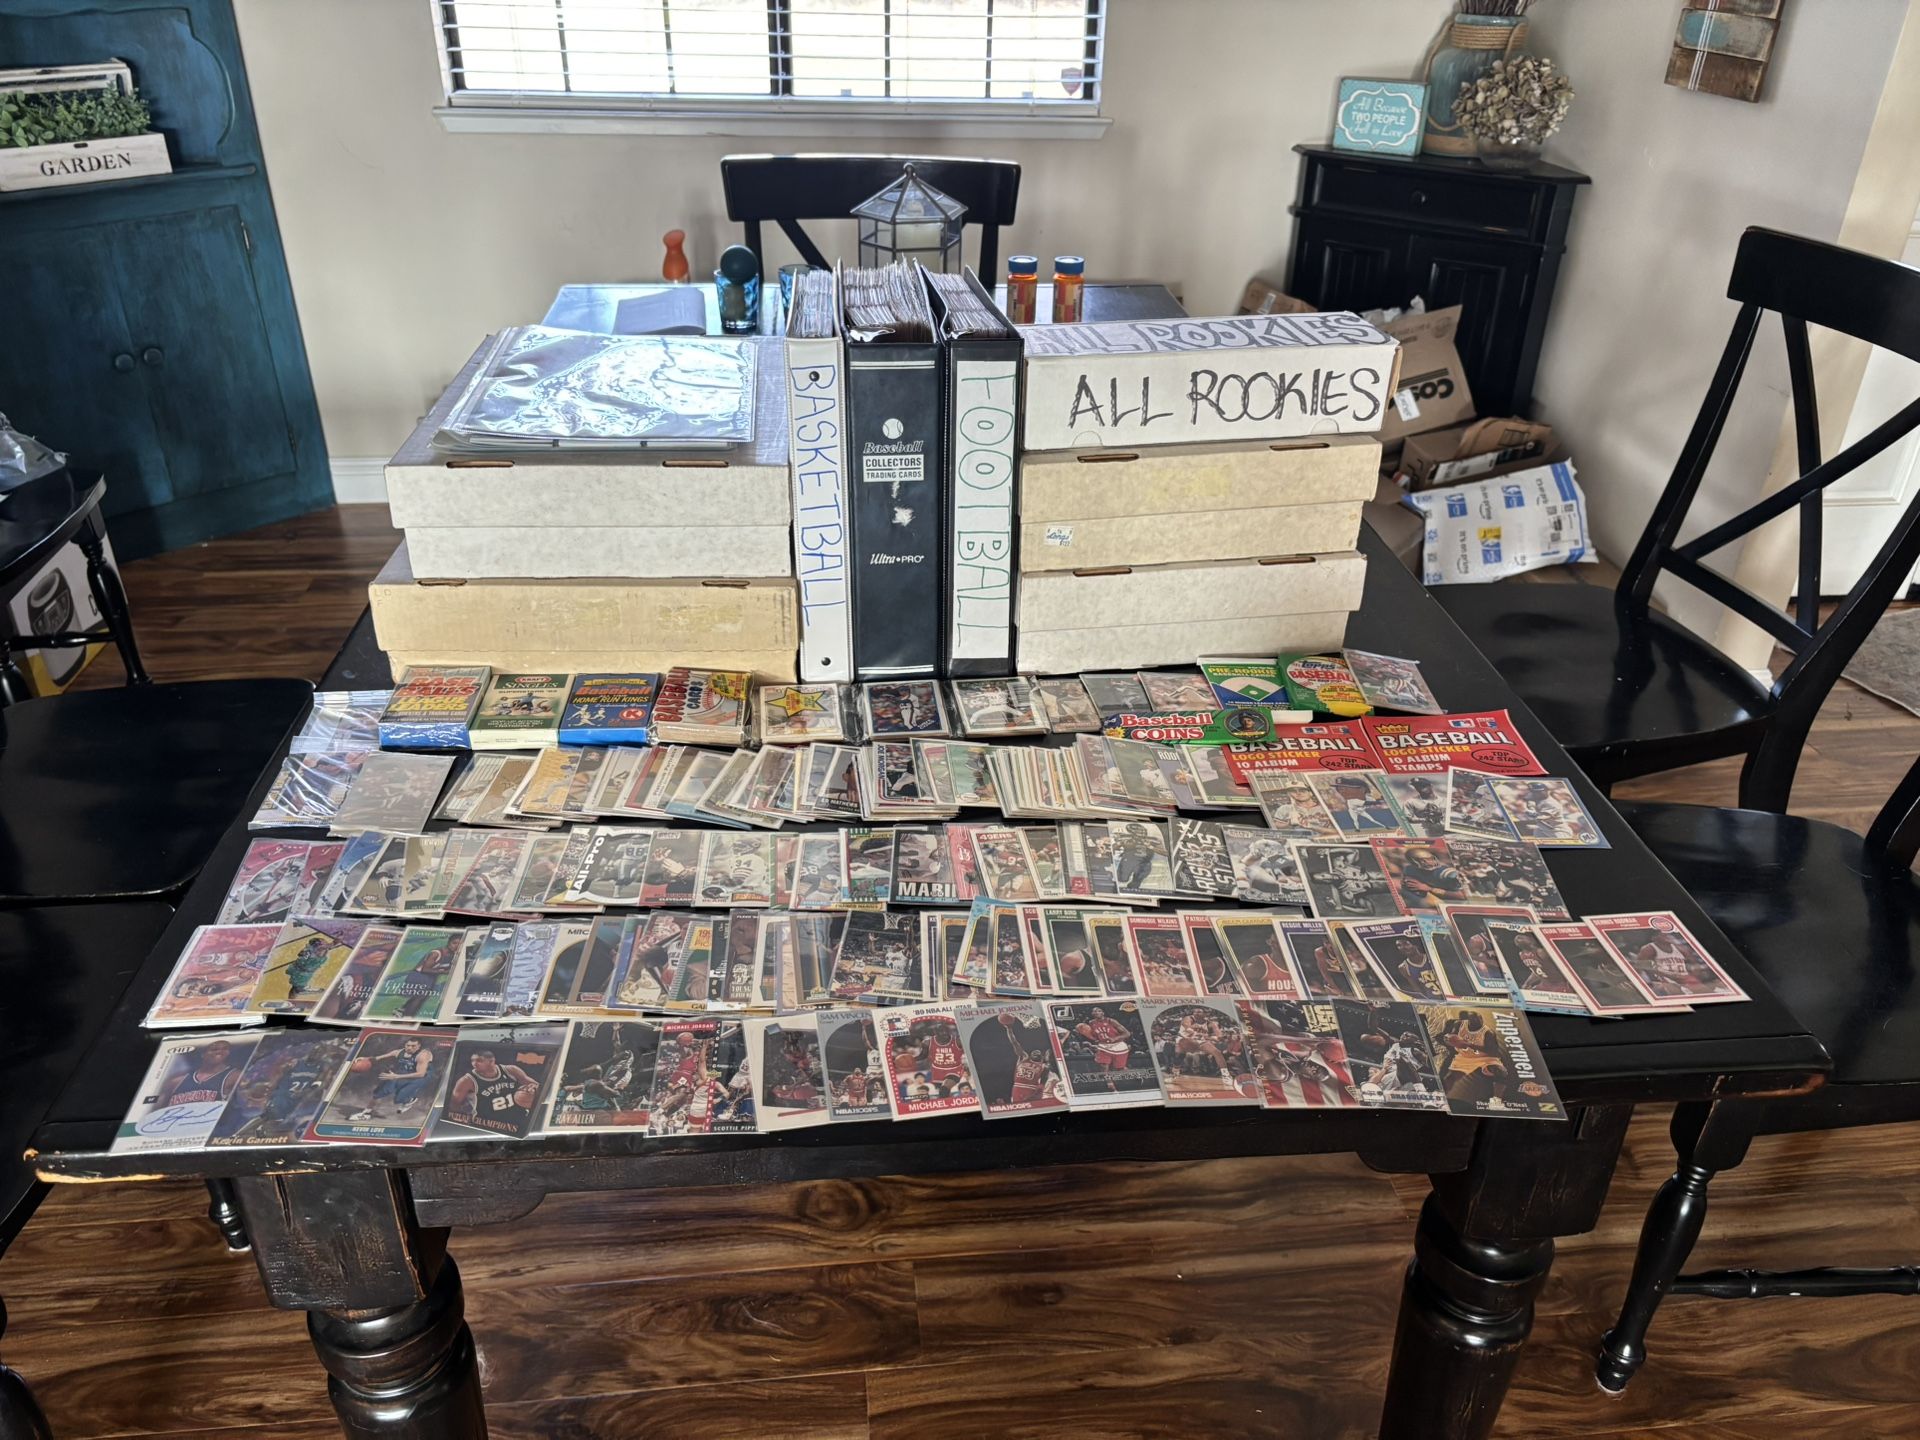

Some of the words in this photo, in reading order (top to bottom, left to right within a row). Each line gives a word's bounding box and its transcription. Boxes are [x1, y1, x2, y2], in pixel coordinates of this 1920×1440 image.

[1352, 112, 1370, 121] TWO
[1372, 113, 1406, 125] PEOPLE
[41, 152, 133, 177] GARDEN
[1135, 316, 1392, 352] ROOKIES
[1068, 374, 1173, 428] ALL
[1186, 368, 1381, 425] ROOKIES
[863, 441, 925, 454] Baseball
[865, 457, 922, 468] COLLECTORS
[866, 471, 894, 479] TRADING
[897, 470, 922, 479] CARDS
[791, 364, 845, 627] BASKETBALL
[957, 374, 1016, 649] FOOTBALL
[407, 676, 479, 686] BASE
[576, 686, 653, 695] Baseball
[387, 703, 469, 711] LEADERS
[1120, 712, 1213, 727] Baseball
[1131, 728, 1204, 740] COINS
[1229, 738, 1366, 753] BASEBALL
[1377, 732, 1516, 749] BASEBALL
[1384, 748, 1416, 756] LOGO
[1407, 754, 1451, 762] ALBUM
[1255, 759, 1298, 767] ALBUM
[1394, 763, 1443, 771] STAMPS
[977, 832, 1016, 841] 49ERS
[625, 848, 644, 856] 88
[572, 835, 606, 894] All-Pro
[898, 882, 957, 897] MARI
[1485, 980, 1507, 988] PISTON
[959, 1008, 997, 1017] MICHAEL
[998, 1005, 1032, 1014] JORDAN
[1491, 1011, 1538, 1079] Zupermen
[935, 1053, 955, 1062] 23
[481, 1082, 515, 1097] SPURS
[491, 1094, 515, 1111] 21
[908, 1100, 948, 1111] MICHAEL
[950, 1097, 980, 1107] JORDA
[472, 1116, 518, 1133] CHAMPIONS
[555, 1115, 571, 1125] RAY
[573, 1114, 595, 1124] ALLEN
[212, 1136, 243, 1146] Kevin
